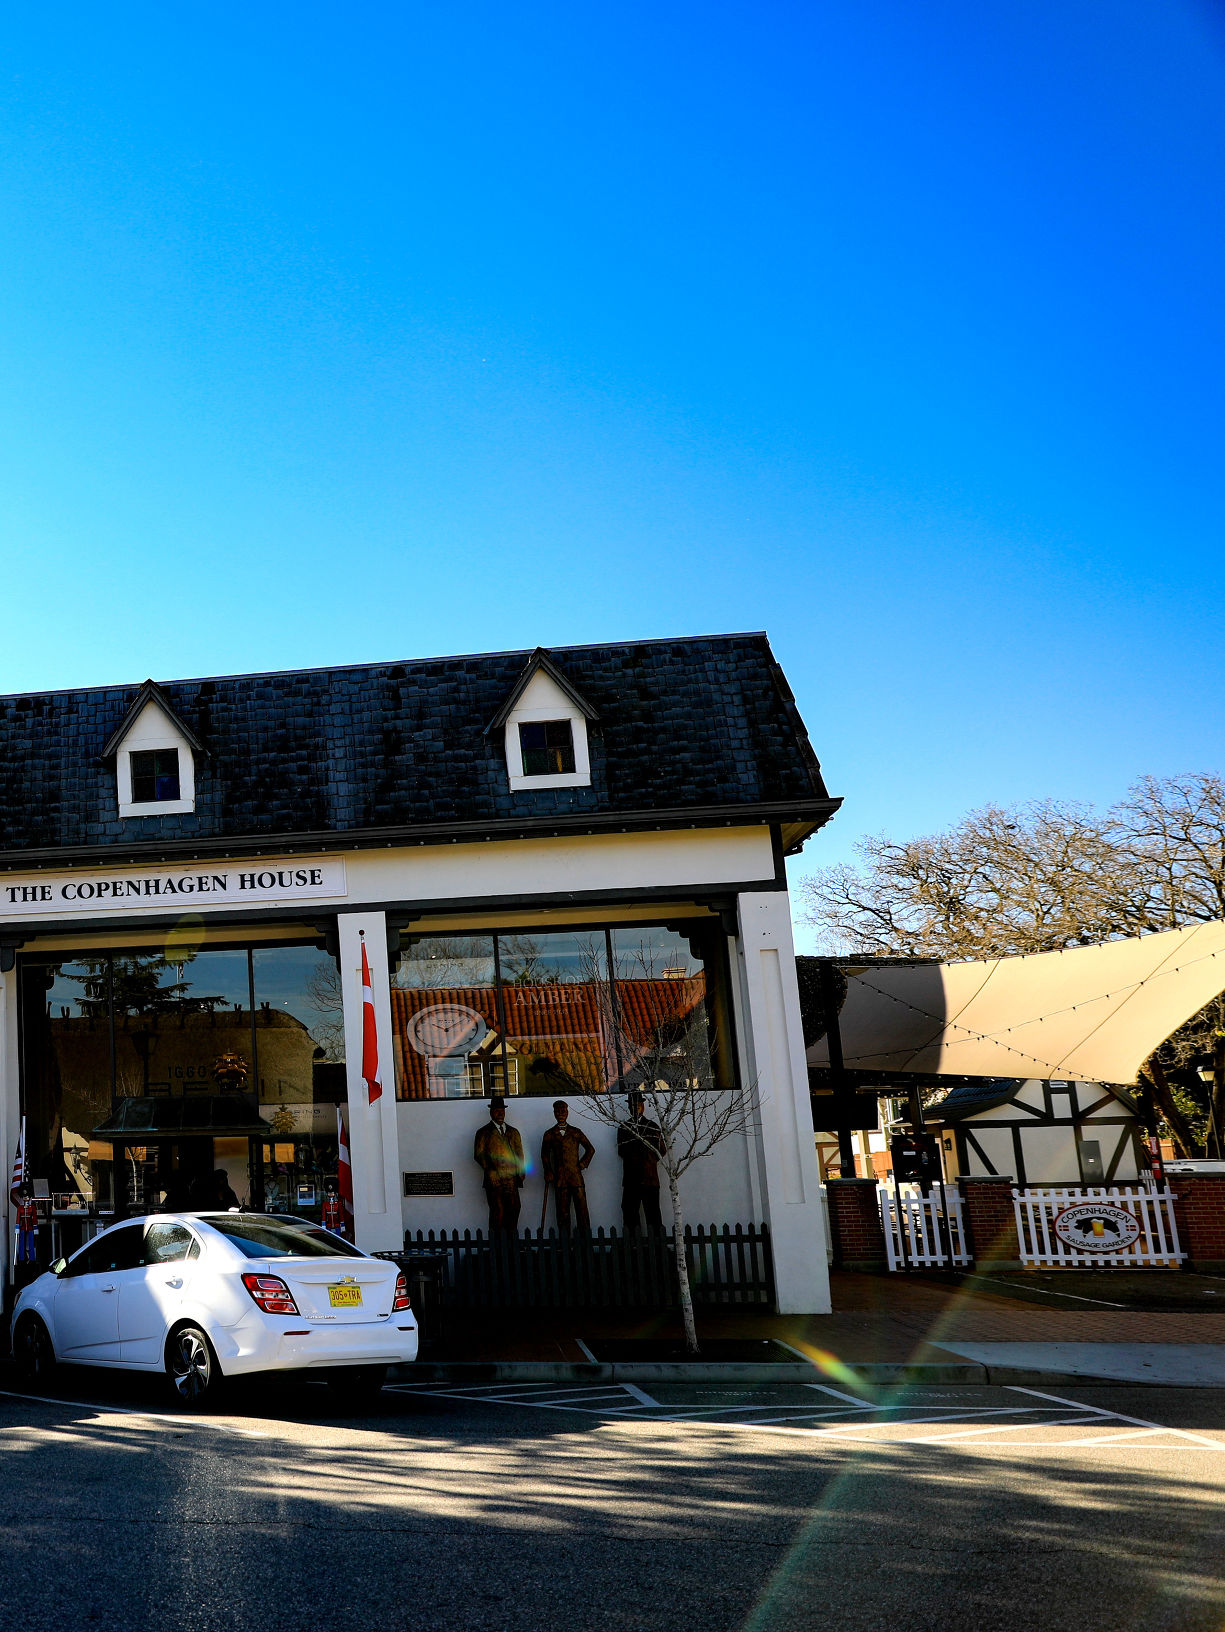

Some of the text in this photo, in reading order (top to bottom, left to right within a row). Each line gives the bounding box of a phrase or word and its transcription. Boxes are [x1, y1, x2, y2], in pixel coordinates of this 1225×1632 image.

[5, 868, 324, 903] THE COPENHAGEN HOUSE
[513, 989, 587, 1006] AMBER
[1061, 1207, 1131, 1224] COPENHAGEN
[1065, 1234, 1133, 1249] SAUSAGE GARDEN
